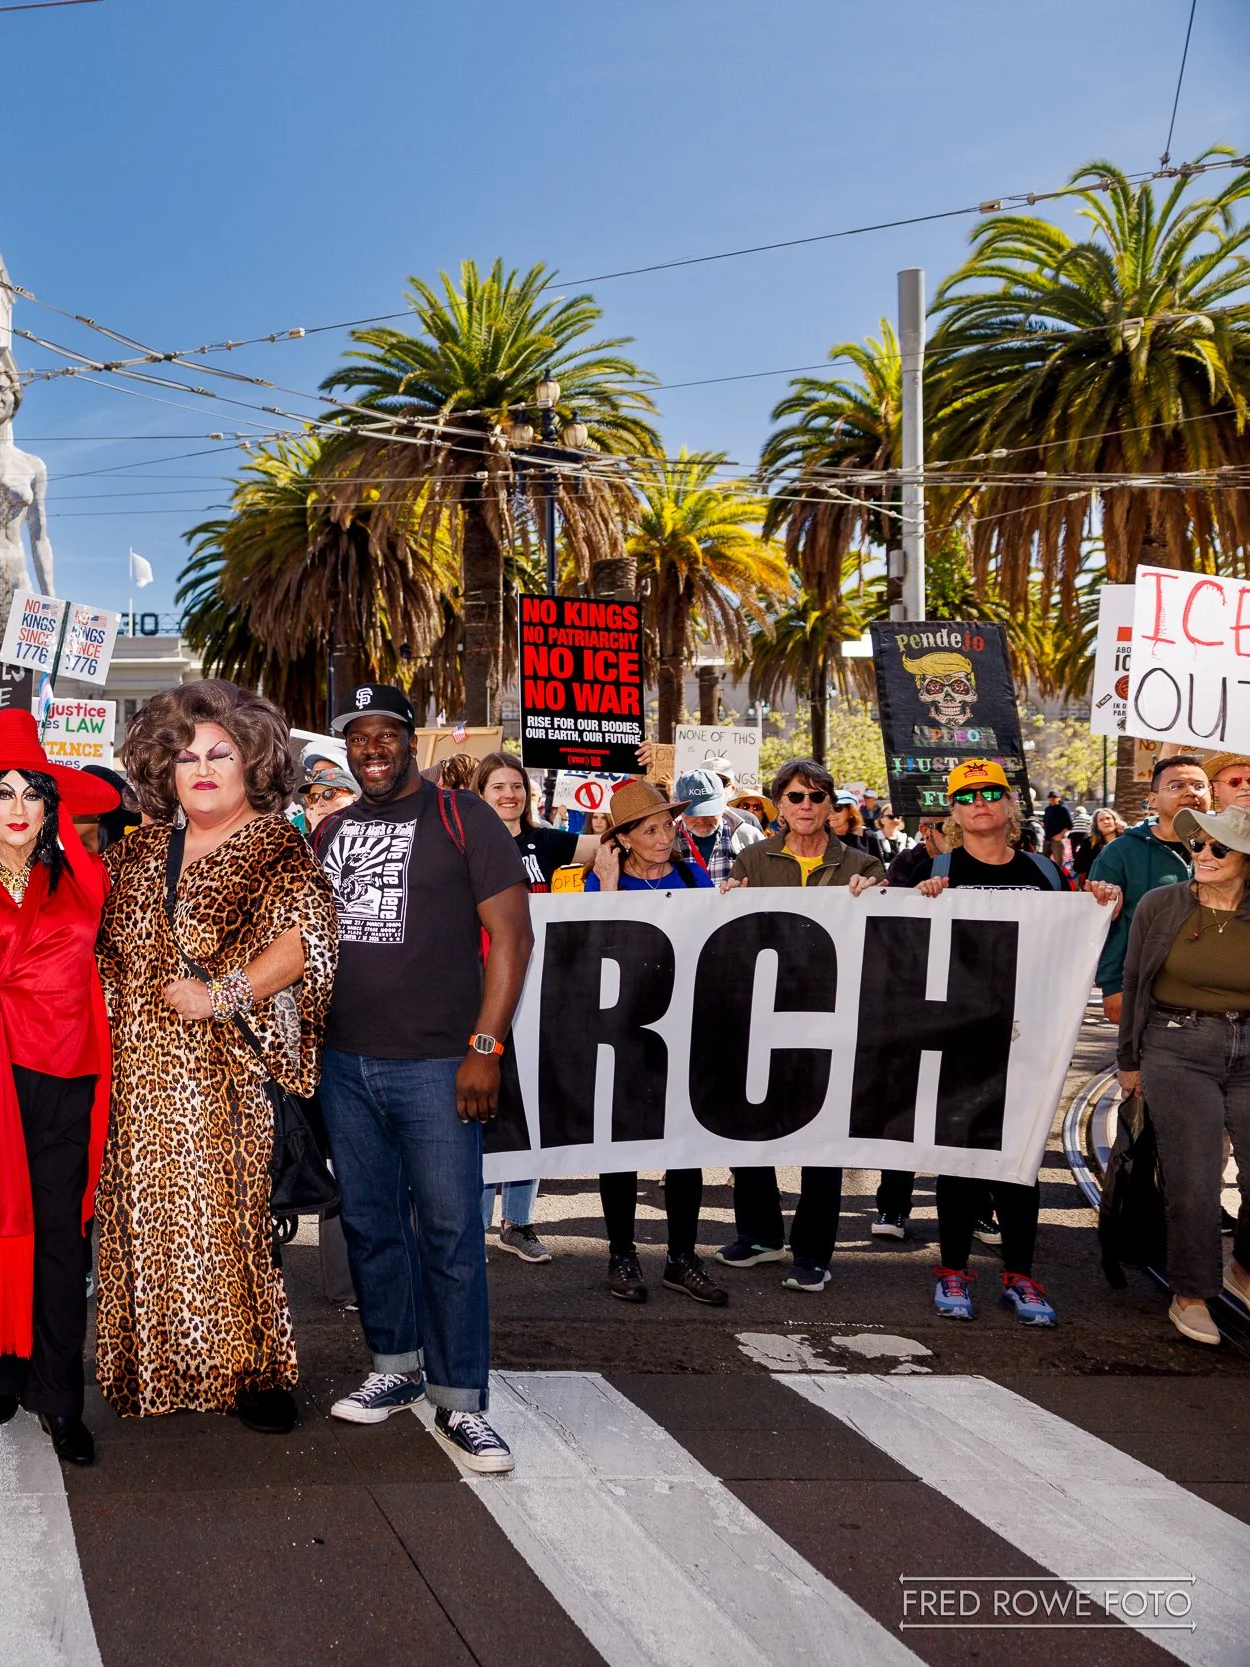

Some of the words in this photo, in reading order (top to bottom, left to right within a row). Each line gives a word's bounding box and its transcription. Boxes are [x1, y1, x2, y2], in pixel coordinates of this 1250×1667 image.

[24, 599, 41, 614] NO
[523, 598, 557, 625] NO
[564, 601, 639, 630] KINGS
[21, 612, 56, 633] KINGS
[523, 625, 545, 644] NO
[549, 628, 639, 651] PATRIARCHY
[16, 642, 49, 664] 1776
[1116, 646, 1132, 654] ABO
[524, 645, 574, 679] NO
[583, 649, 640, 684] ICE
[1114, 654, 1132, 671] IC
[524, 679, 565, 711] NO
[573, 682, 640, 715] WAR
[1134, 667, 1250, 742] OU
[65, 717, 105, 734] LAW
[527, 715, 551, 728] RISE
[554, 717, 575, 730] FOR
[577, 718, 599, 731] OUR
[601, 720, 642, 735] BODIES,
[526, 728, 546, 739] OUR
[548, 729, 581, 743] EARTH,
[583, 732, 603, 743] OUR
[605, 733, 641, 745] FUTURE
[679, 730, 708, 742] NONE
[710, 731, 727, 742] OF
[732, 732, 756, 745] THIS
[42, 741, 103, 757] TANCE
[387, 838, 410, 859] We
[383, 862, 404, 885] Are
[553, 873, 580, 889] OPE
[379, 888, 403, 919] Here
[483, 911, 1019, 1153] RCH
